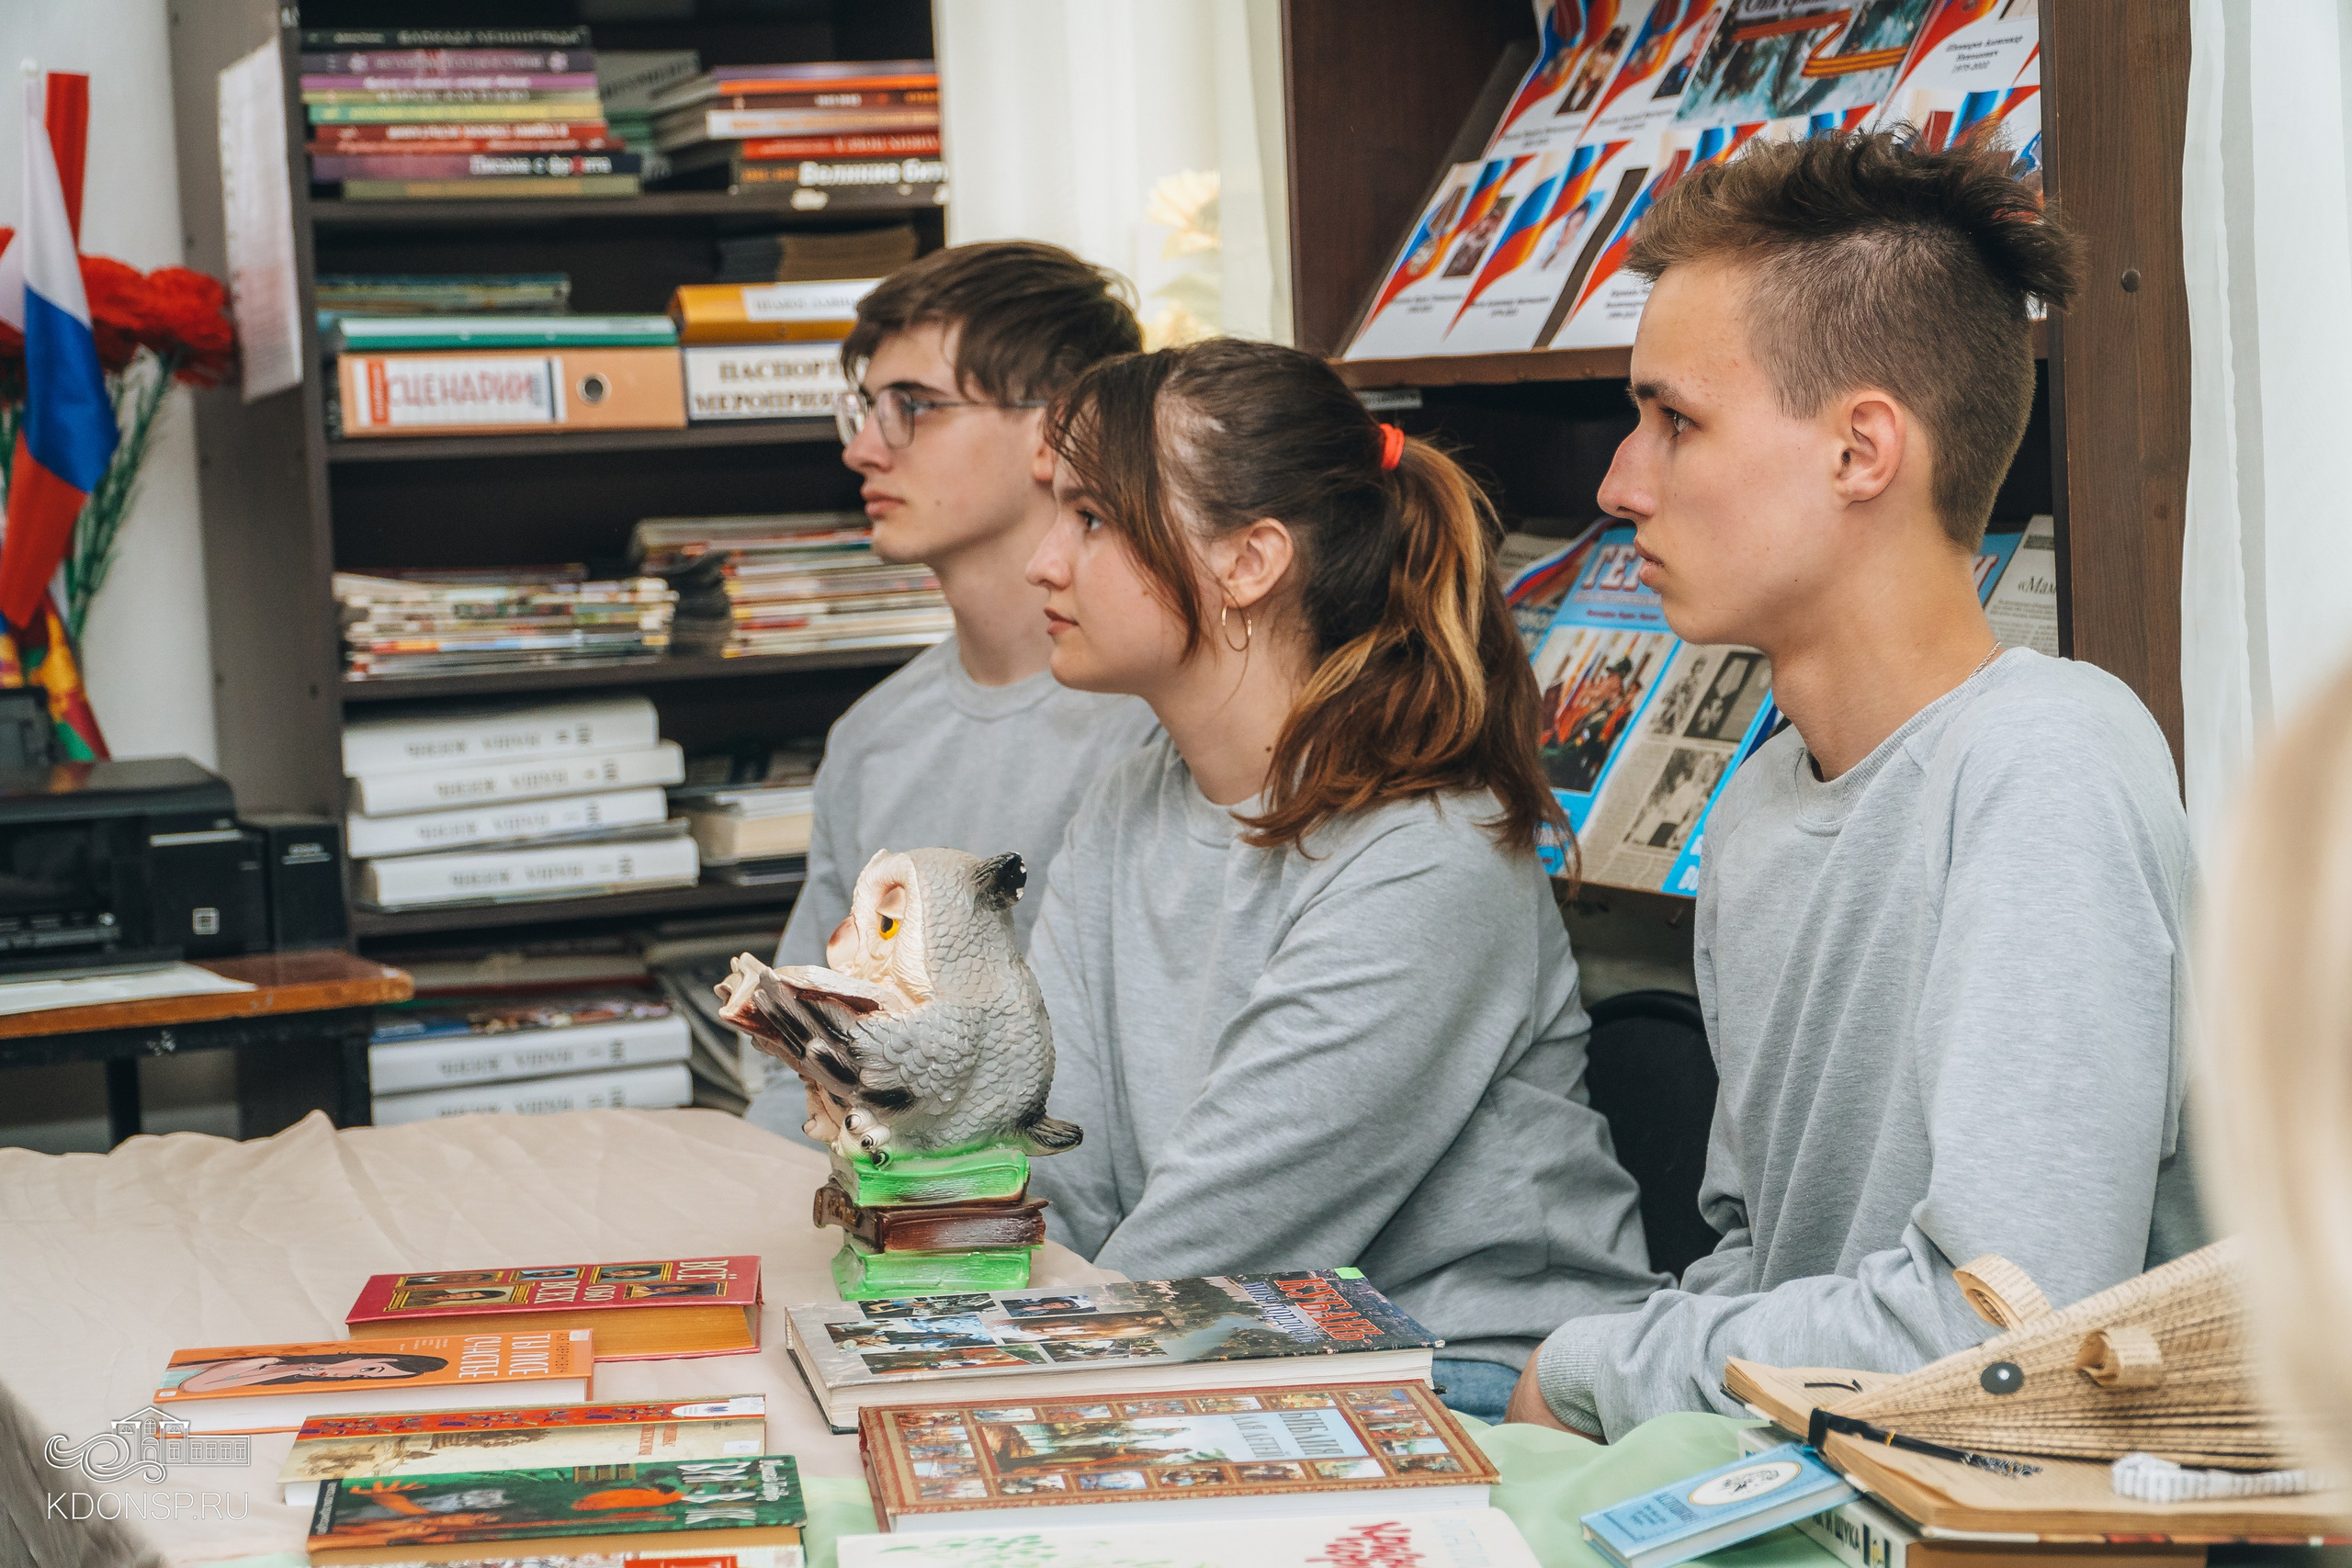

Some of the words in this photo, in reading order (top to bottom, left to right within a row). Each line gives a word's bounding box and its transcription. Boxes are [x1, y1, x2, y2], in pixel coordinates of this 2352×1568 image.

[676, 1259, 737, 1280] ВСЁ
[534, 1280, 581, 1303] ВСЕХ
[582, 1284, 616, 1302] ОБО
[511, 1333, 551, 1349] ТЫ
[458, 1336, 502, 1379] СЧАСТЬЕ
[508, 1351, 549, 1376] МОЕ
[1231, 1415, 1268, 1431] ДЛЯ
[1278, 1412, 1344, 1455] БИБЛИЯ
[1240, 1432, 1292, 1458] ДЕТЕЙ
